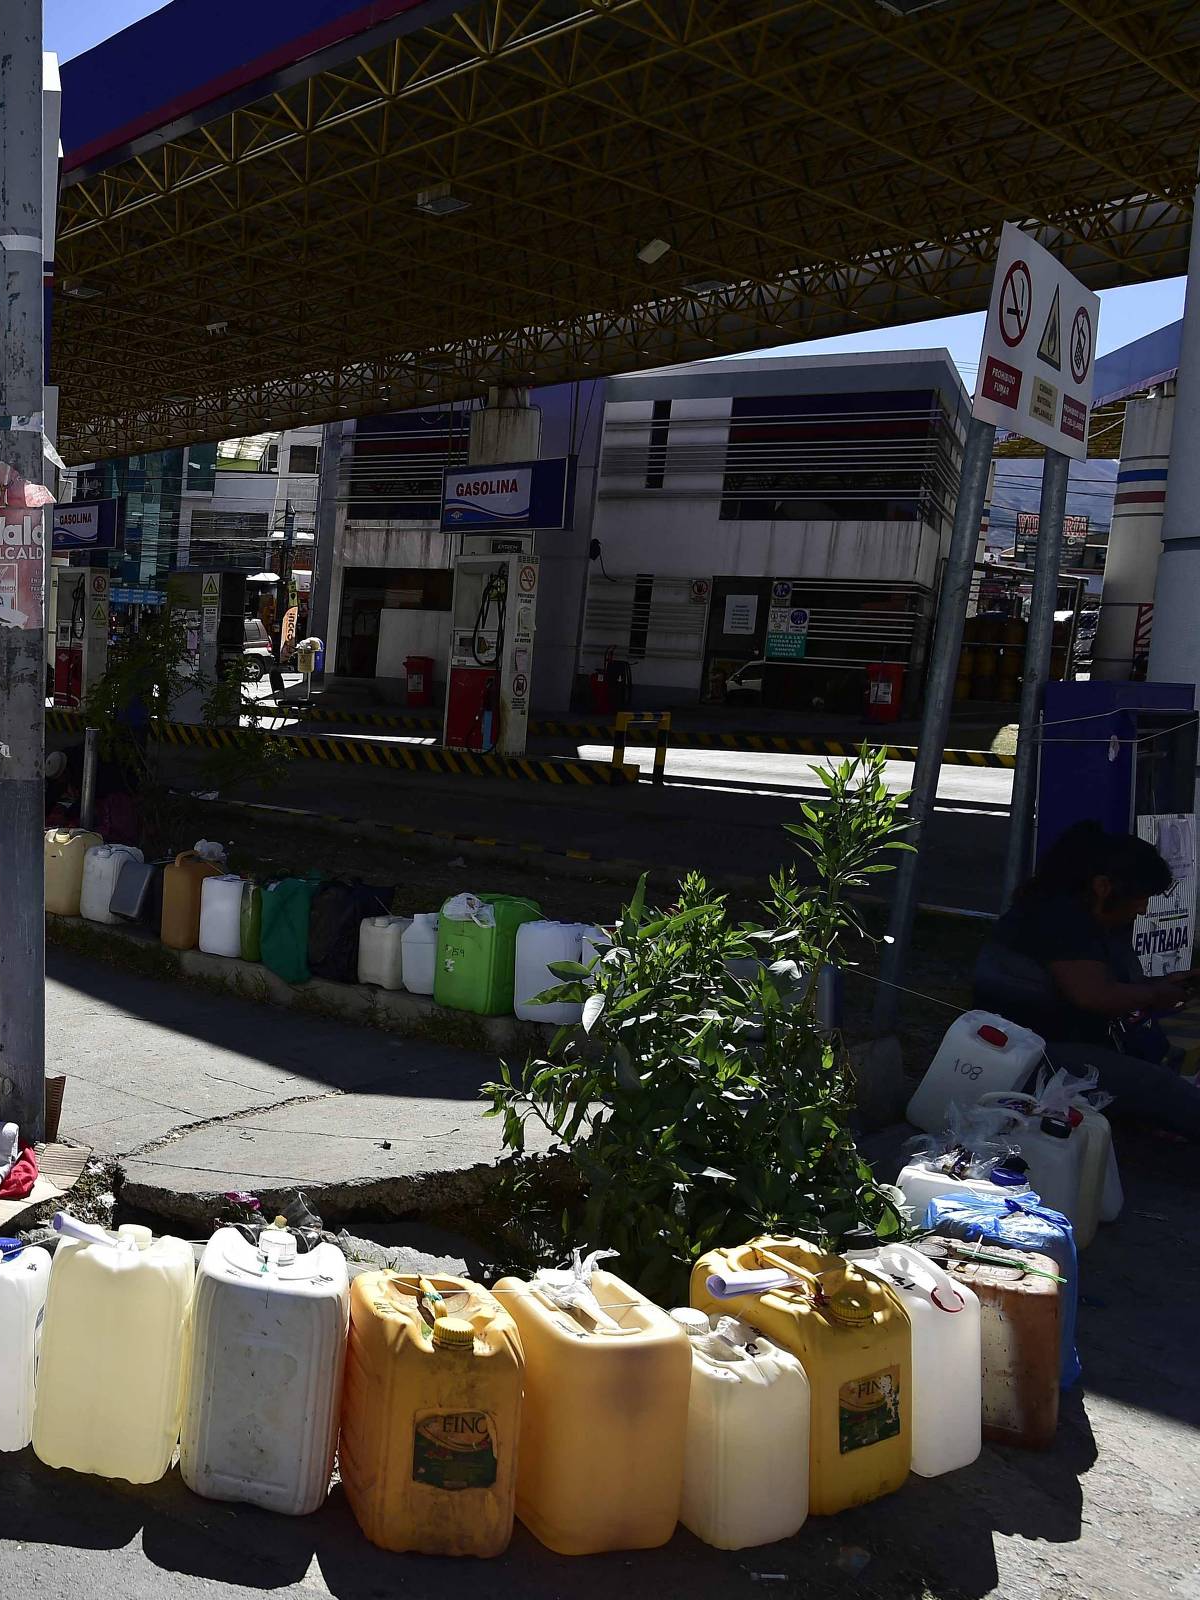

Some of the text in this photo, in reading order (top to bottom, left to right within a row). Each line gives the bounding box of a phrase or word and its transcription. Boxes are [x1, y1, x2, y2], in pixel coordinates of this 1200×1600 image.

[456, 478, 519, 497] GASOLINA
[59, 512, 92, 525] GASOLINA
[1135, 926, 1189, 956] ENTRADA
[954, 1058, 984, 1081] 108
